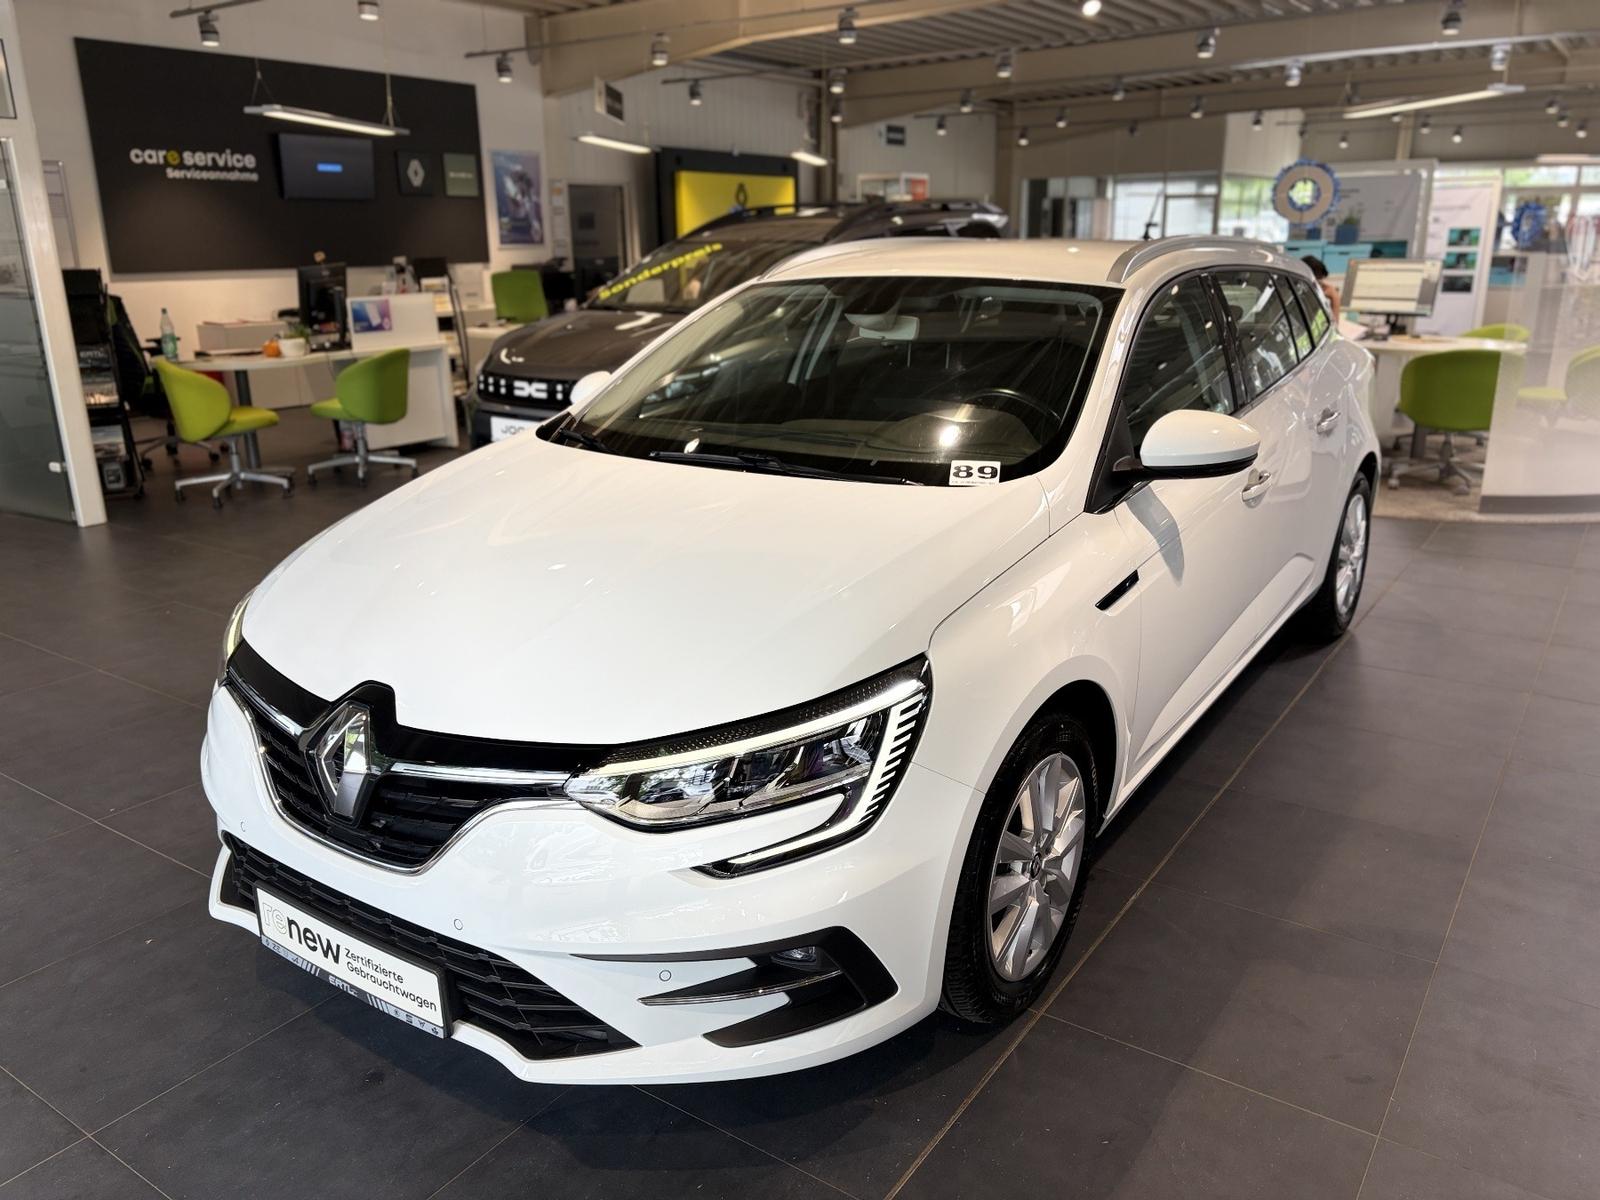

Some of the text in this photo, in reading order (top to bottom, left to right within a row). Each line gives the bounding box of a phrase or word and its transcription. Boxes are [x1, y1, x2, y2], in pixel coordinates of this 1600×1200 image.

[129, 148, 256, 168] care service
[952, 465, 998, 479] 89
[262, 902, 341, 964] renew
[344, 947, 404, 984] Zertifizierte
[346, 961, 437, 1012] Gebrauchtwagen
